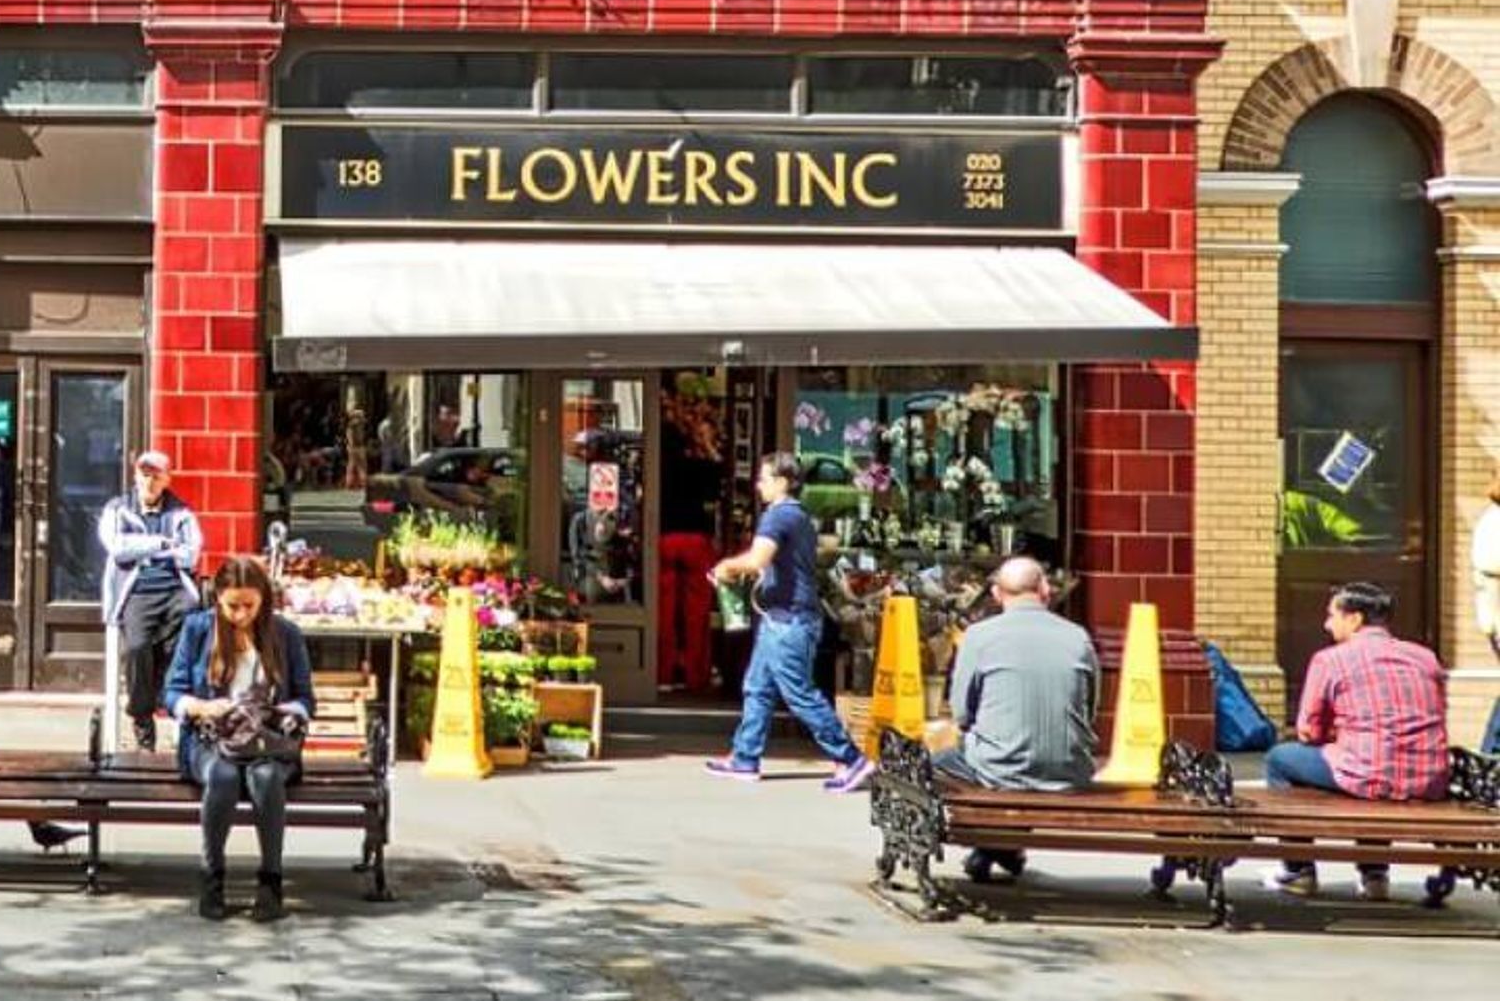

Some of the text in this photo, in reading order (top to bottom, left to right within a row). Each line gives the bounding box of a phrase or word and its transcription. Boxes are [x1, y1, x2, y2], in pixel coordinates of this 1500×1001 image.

[966, 152, 1002, 170] 020
[338, 146, 899, 208] 138 FLOWERS INC
[962, 172, 1005, 190] 7373
[964, 191, 1004, 209] 3041
